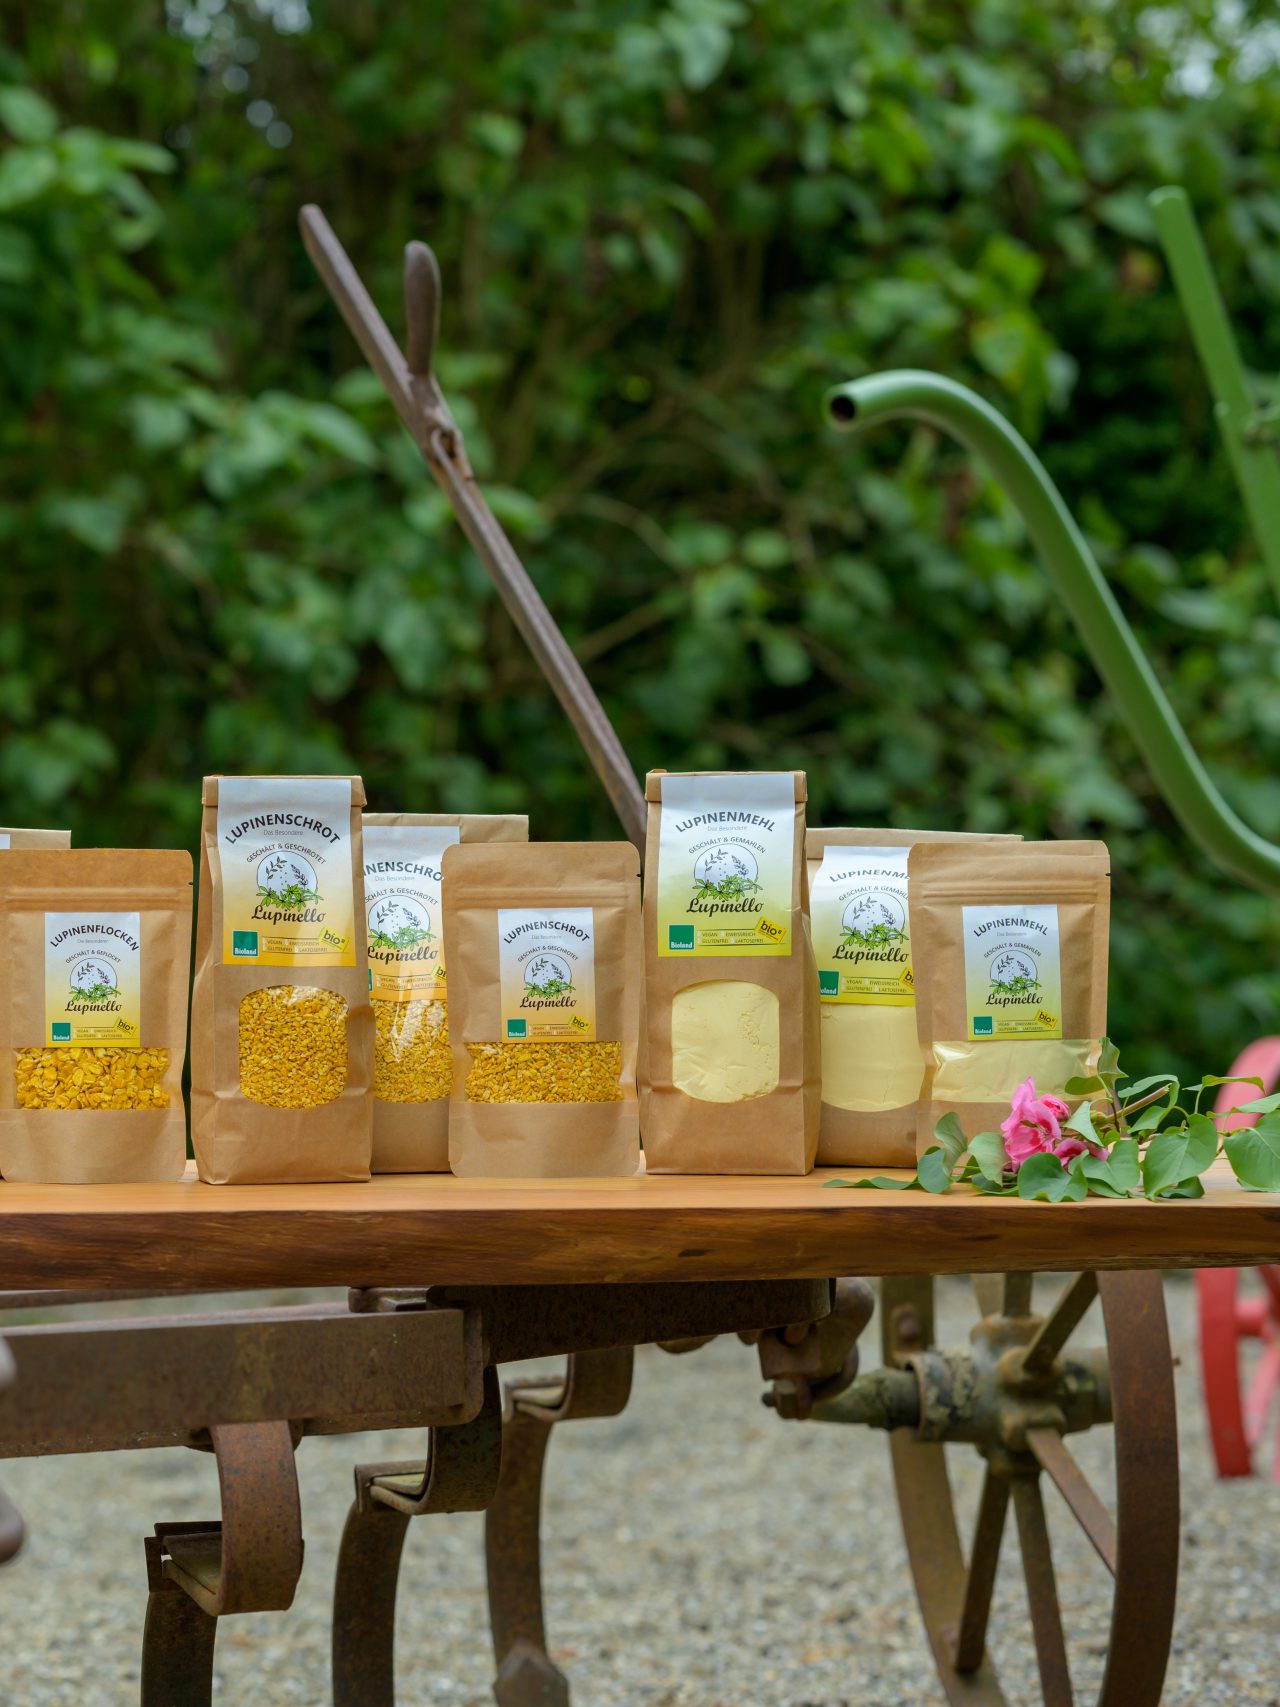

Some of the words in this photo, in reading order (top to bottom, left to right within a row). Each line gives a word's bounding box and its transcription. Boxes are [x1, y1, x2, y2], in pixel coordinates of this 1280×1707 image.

[225, 814, 341, 844] LUPINENSCHROT
[675, 811, 776, 832] LUPINENMEHL
[246, 843, 275, 863] GESCHÄLT
[285, 843, 326, 865] GESCHROTET
[689, 837, 721, 854] GESCHÄLT
[730, 837, 766, 854] GEMAHLEN
[365, 888, 387, 904] SCHÄLT
[397, 888, 438, 905] GESCHROTET
[839, 886, 872, 901] GESCHÄLT
[881, 886, 909, 901] GEMAHL
[251, 905, 327, 925] Lupinello
[686, 899, 764, 917] Lupinello
[504, 921, 590, 944] LUPINENSCHROT
[973, 918, 1048, 937] LUPINENMEHL
[50, 925, 139, 951] LUPINENFLOCKEN
[66, 950, 90, 964] GESCHÄLT
[97, 950, 121, 963] GEFLOCKT
[368, 946, 438, 965] Lupinello
[518, 946, 540, 962] GESCHÄLT
[832, 945, 909, 965] Lupinello
[984, 943, 1007, 958] GESCHÄLT
[65, 1001, 122, 1015] Lupinello
[520, 996, 576, 1010] Lupinello
[986, 993, 1043, 1008] Lupinello
